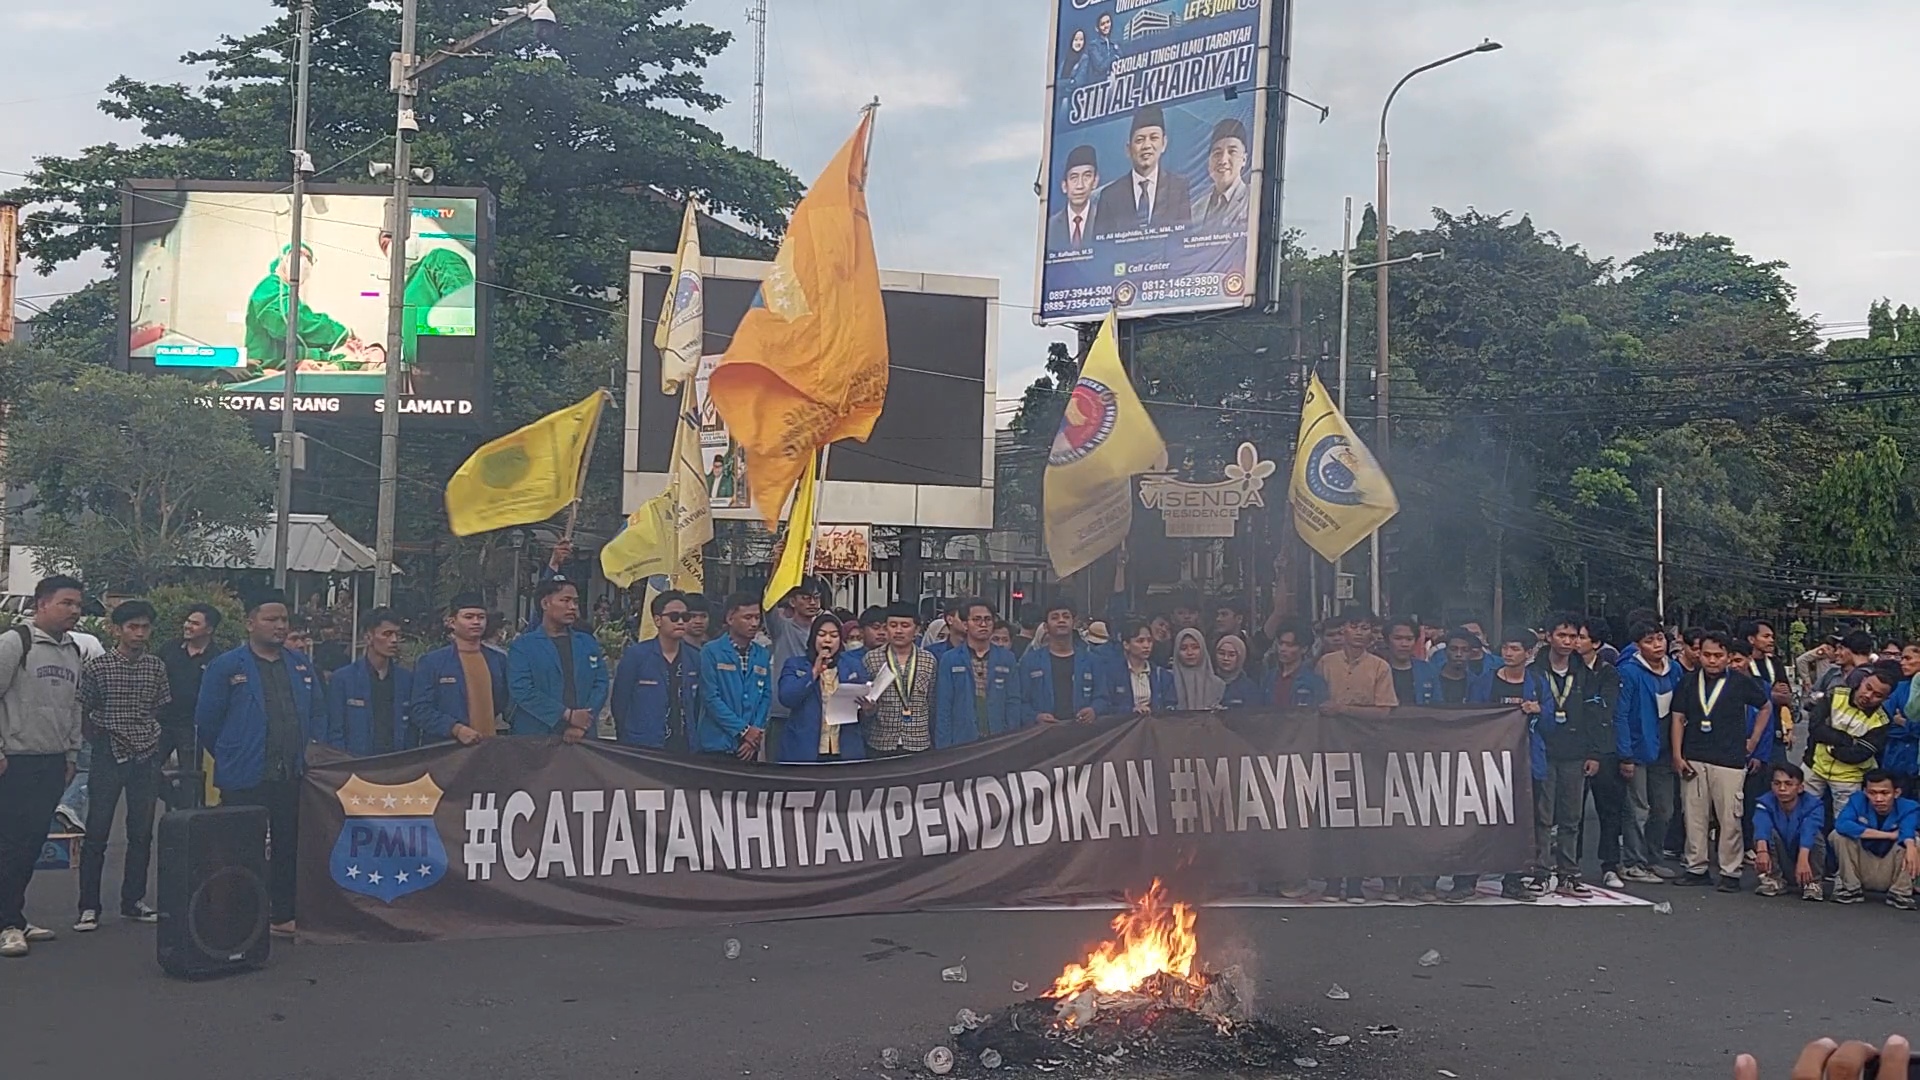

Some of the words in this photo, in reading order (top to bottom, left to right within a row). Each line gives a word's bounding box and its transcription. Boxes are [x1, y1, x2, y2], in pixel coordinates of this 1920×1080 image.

[1111, 51, 1149, 75] SEKOLAH
[1150, 43, 1181, 66] TINGGI
[1181, 36, 1204, 57] ILMU
[1204, 25, 1252, 52] TARBIYAH
[1069, 80, 1113, 124] STIT
[1108, 43, 1255, 116] AL-KHAIRIYAH
[1128, 264, 1144, 273] Call
[1144, 262, 1171, 271] Center
[1142, 275, 1219, 291] 0812-1462-9800
[1048, 286, 1113, 301] 0897-3944-500
[1141, 286, 1219, 301] 0878-4014-0922
[269, 397, 340, 412] SRANG
[374, 398, 455, 413] SLAMAT
[1163, 509, 1238, 518] RESIDENCE
[463, 758, 1159, 882] #CATATANHITAMPENDIDIKAN
[1170, 750, 1515, 834] #MAYMELAWAN
[349, 825, 428, 858] PMII
